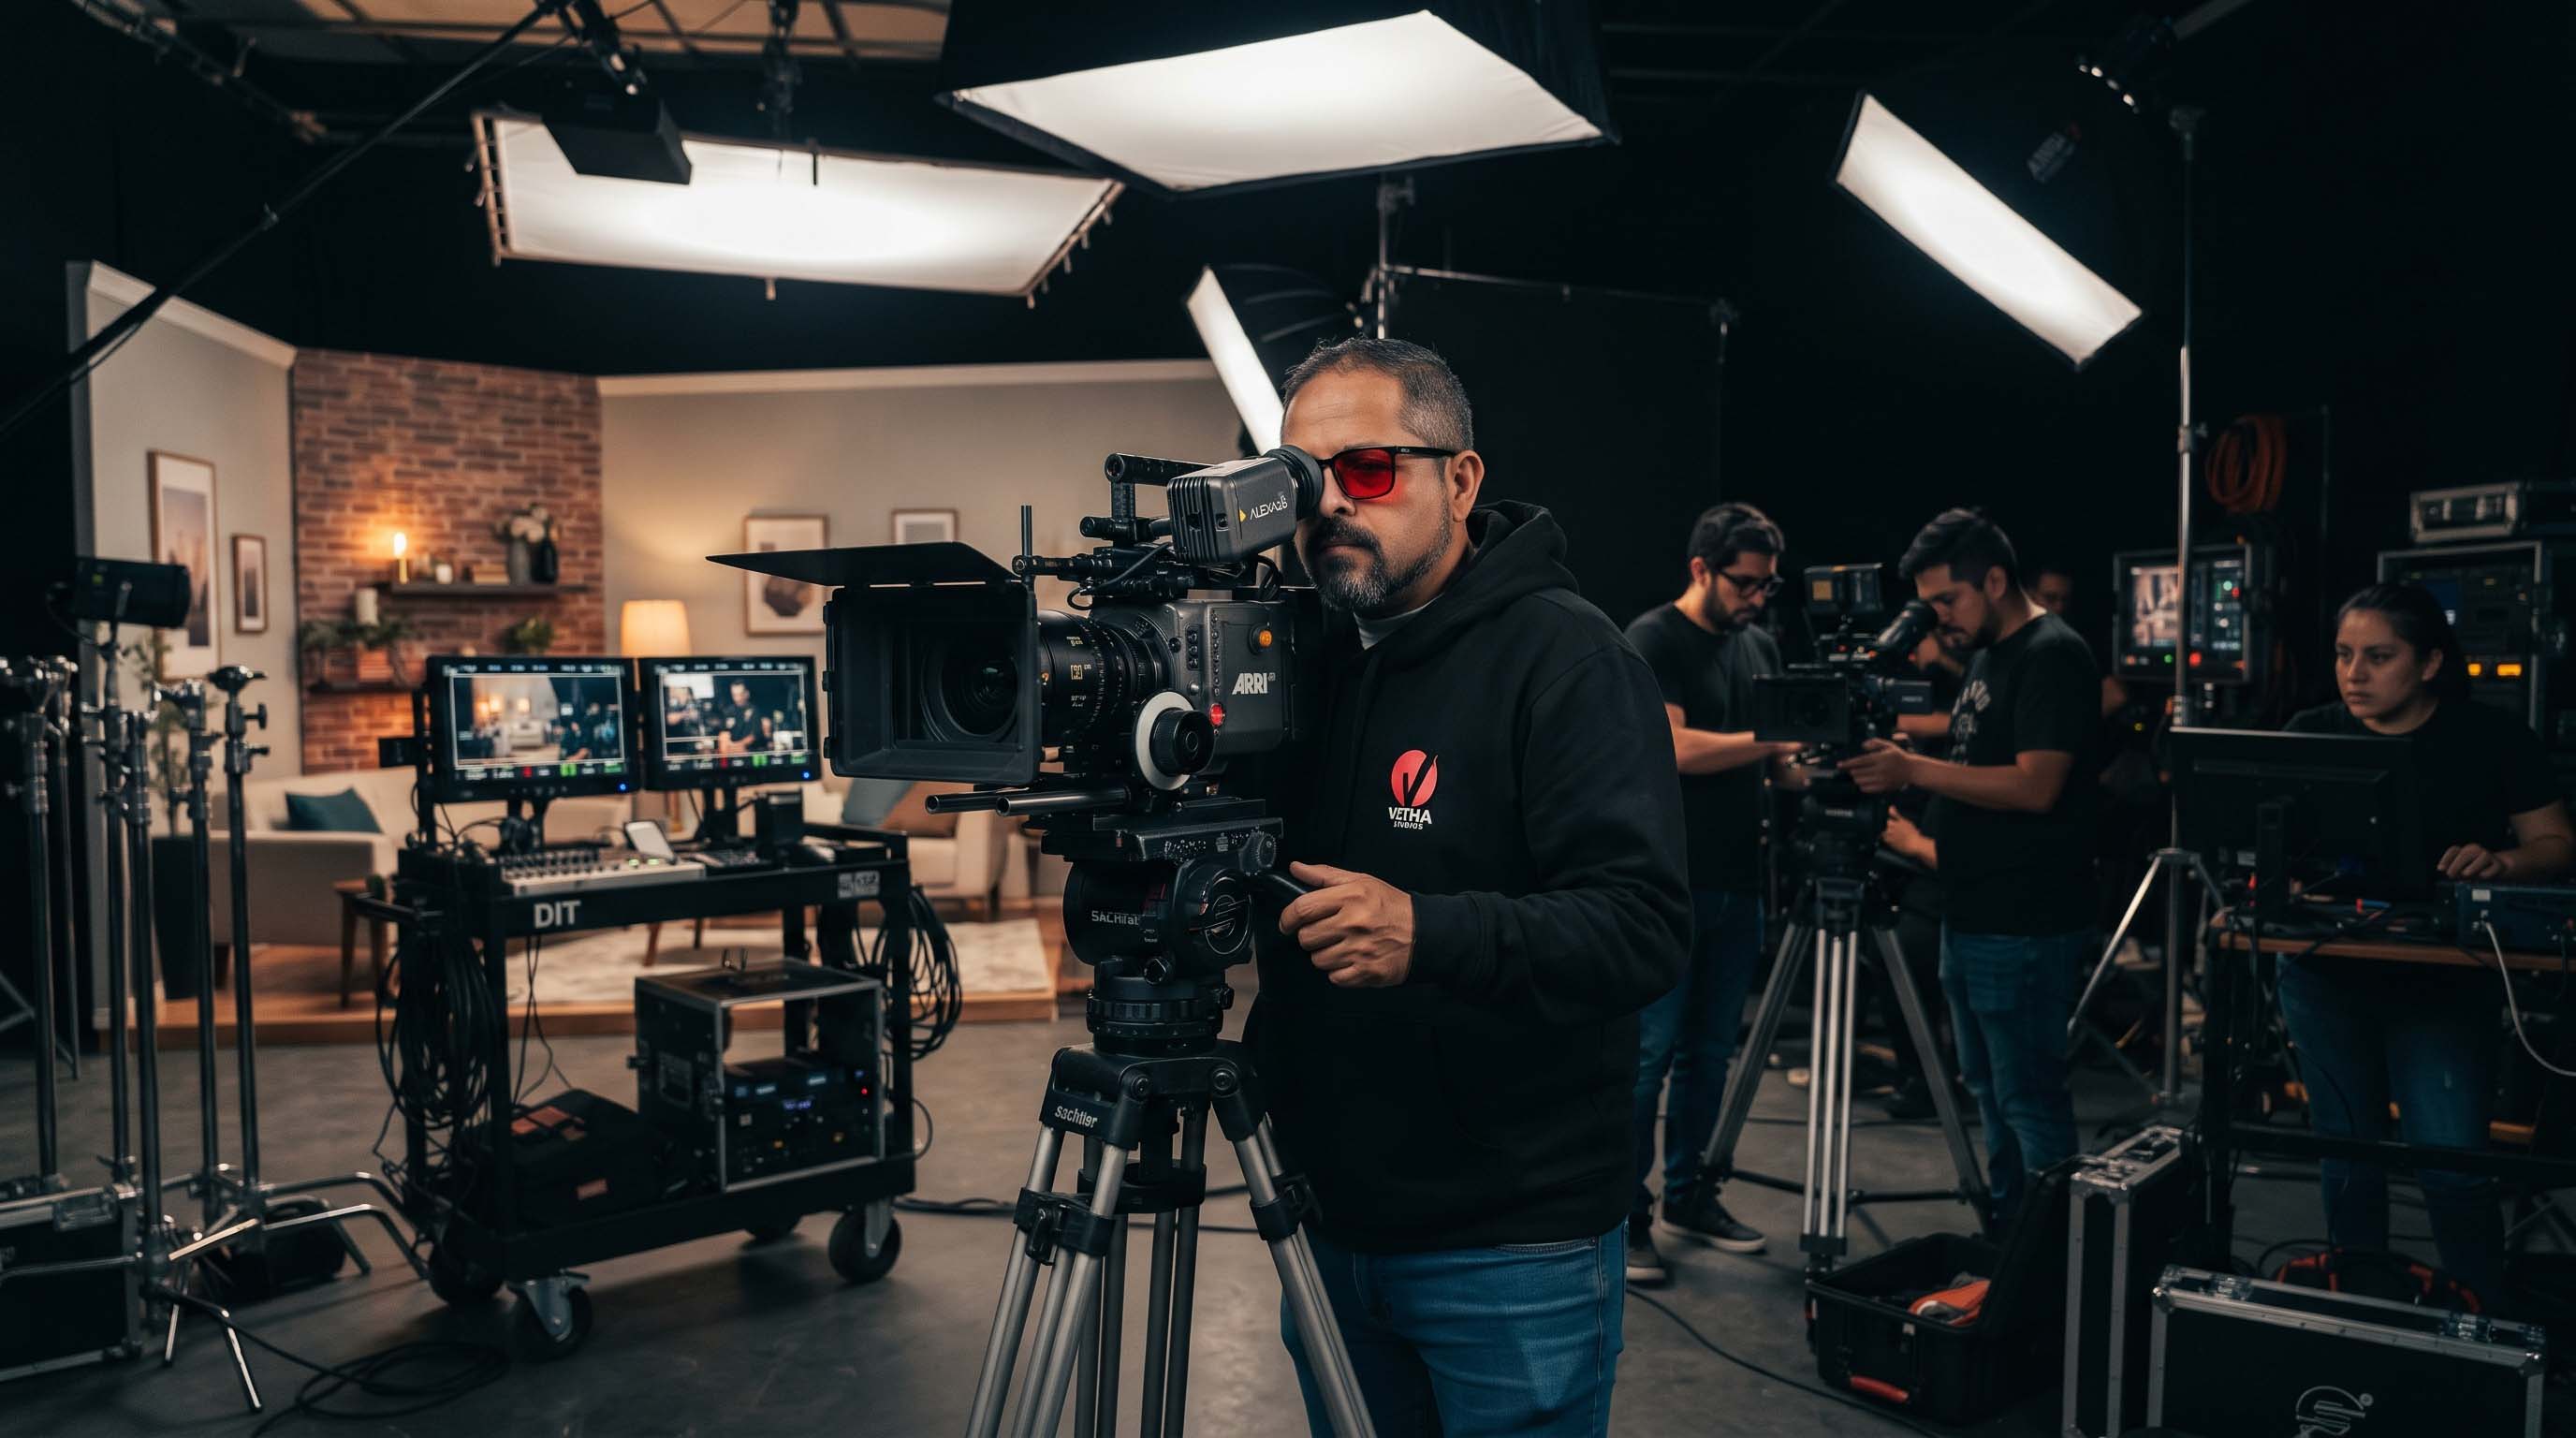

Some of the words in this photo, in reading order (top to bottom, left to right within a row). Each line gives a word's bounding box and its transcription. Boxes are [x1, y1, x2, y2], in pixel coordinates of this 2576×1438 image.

[1232, 672, 1268, 695] ARRI
[1388, 806, 1433, 825] VETHA
[534, 900, 581, 929] DIT
